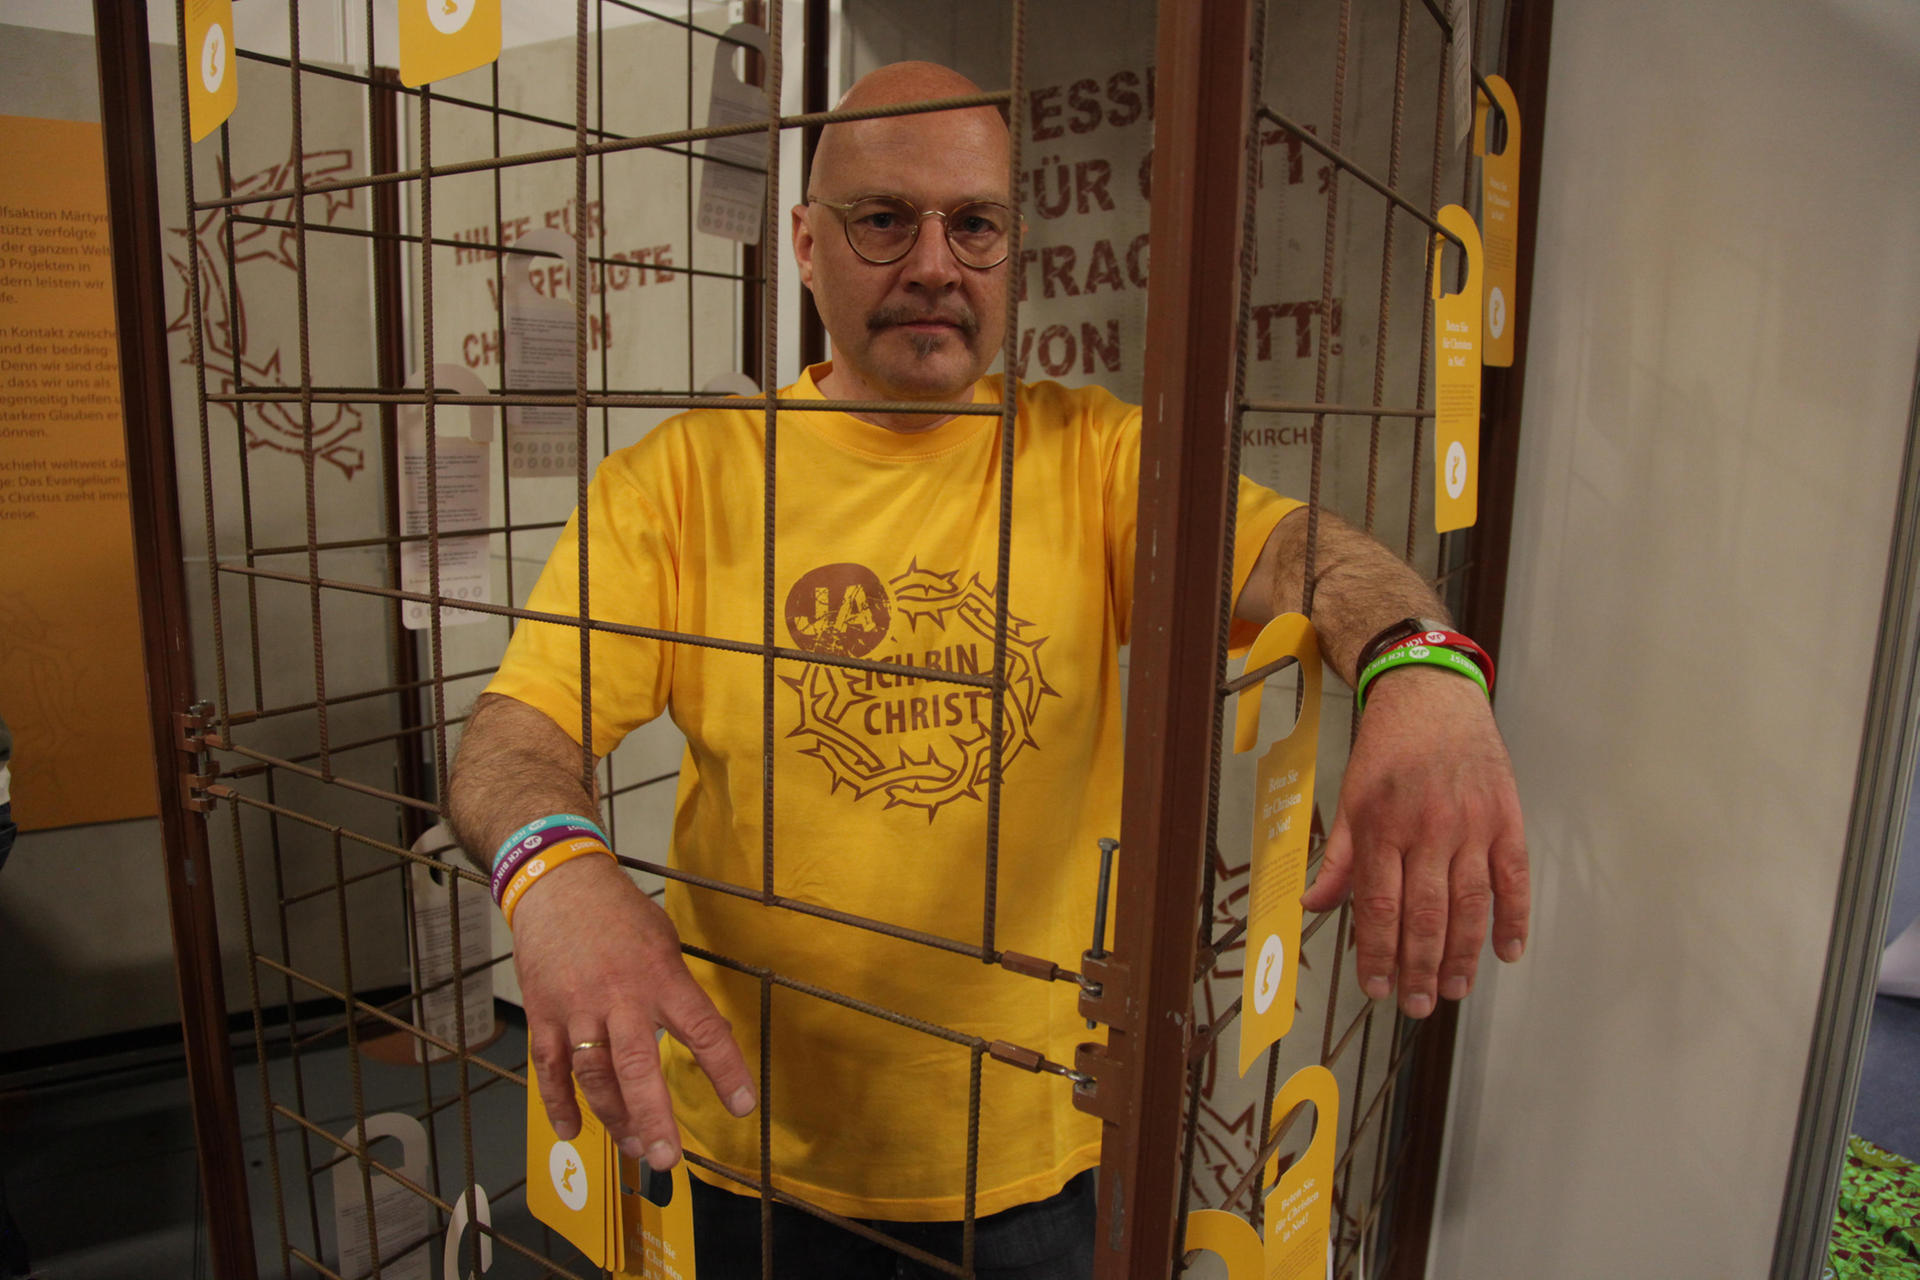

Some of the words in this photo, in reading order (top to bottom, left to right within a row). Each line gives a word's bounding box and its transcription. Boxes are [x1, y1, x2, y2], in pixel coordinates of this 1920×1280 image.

[37, 227, 97, 241] verfolgte
[453, 216, 531, 266] HILFE
[1, 241, 24, 253] der
[28, 246, 78, 257] ganzen
[10, 258, 75, 273] Projekten
[79, 261, 92, 272] in
[0, 276, 32, 288] dern
[36, 276, 81, 289] leisten
[84, 279, 104, 290] wir
[11, 326, 64, 339] Kontakt
[26, 344, 47, 354] der
[1, 359, 37, 371] Denn
[41, 361, 60, 371] wir
[65, 360, 91, 371] sind
[8, 376, 37, 388] dass
[41, 379, 61, 388] wir
[67, 379, 89, 388] uns
[93, 377, 110, 388] als
[49, 409, 103, 422] Glauben
[1243, 427, 1314, 447] KIRCH
[51, 459, 106, 470] weltweit
[18, 475, 42, 487] Das
[45, 475, 120, 489] Evangelium
[8, 490, 61, 503] Christus
[795, 585, 876, 636] JA
[863, 652, 914, 691] ICH
[925, 643, 979, 683] BIN
[863, 690, 984, 736] CHRIST
[507, 848, 523, 864] ICH
[496, 861, 510, 879] BIN
